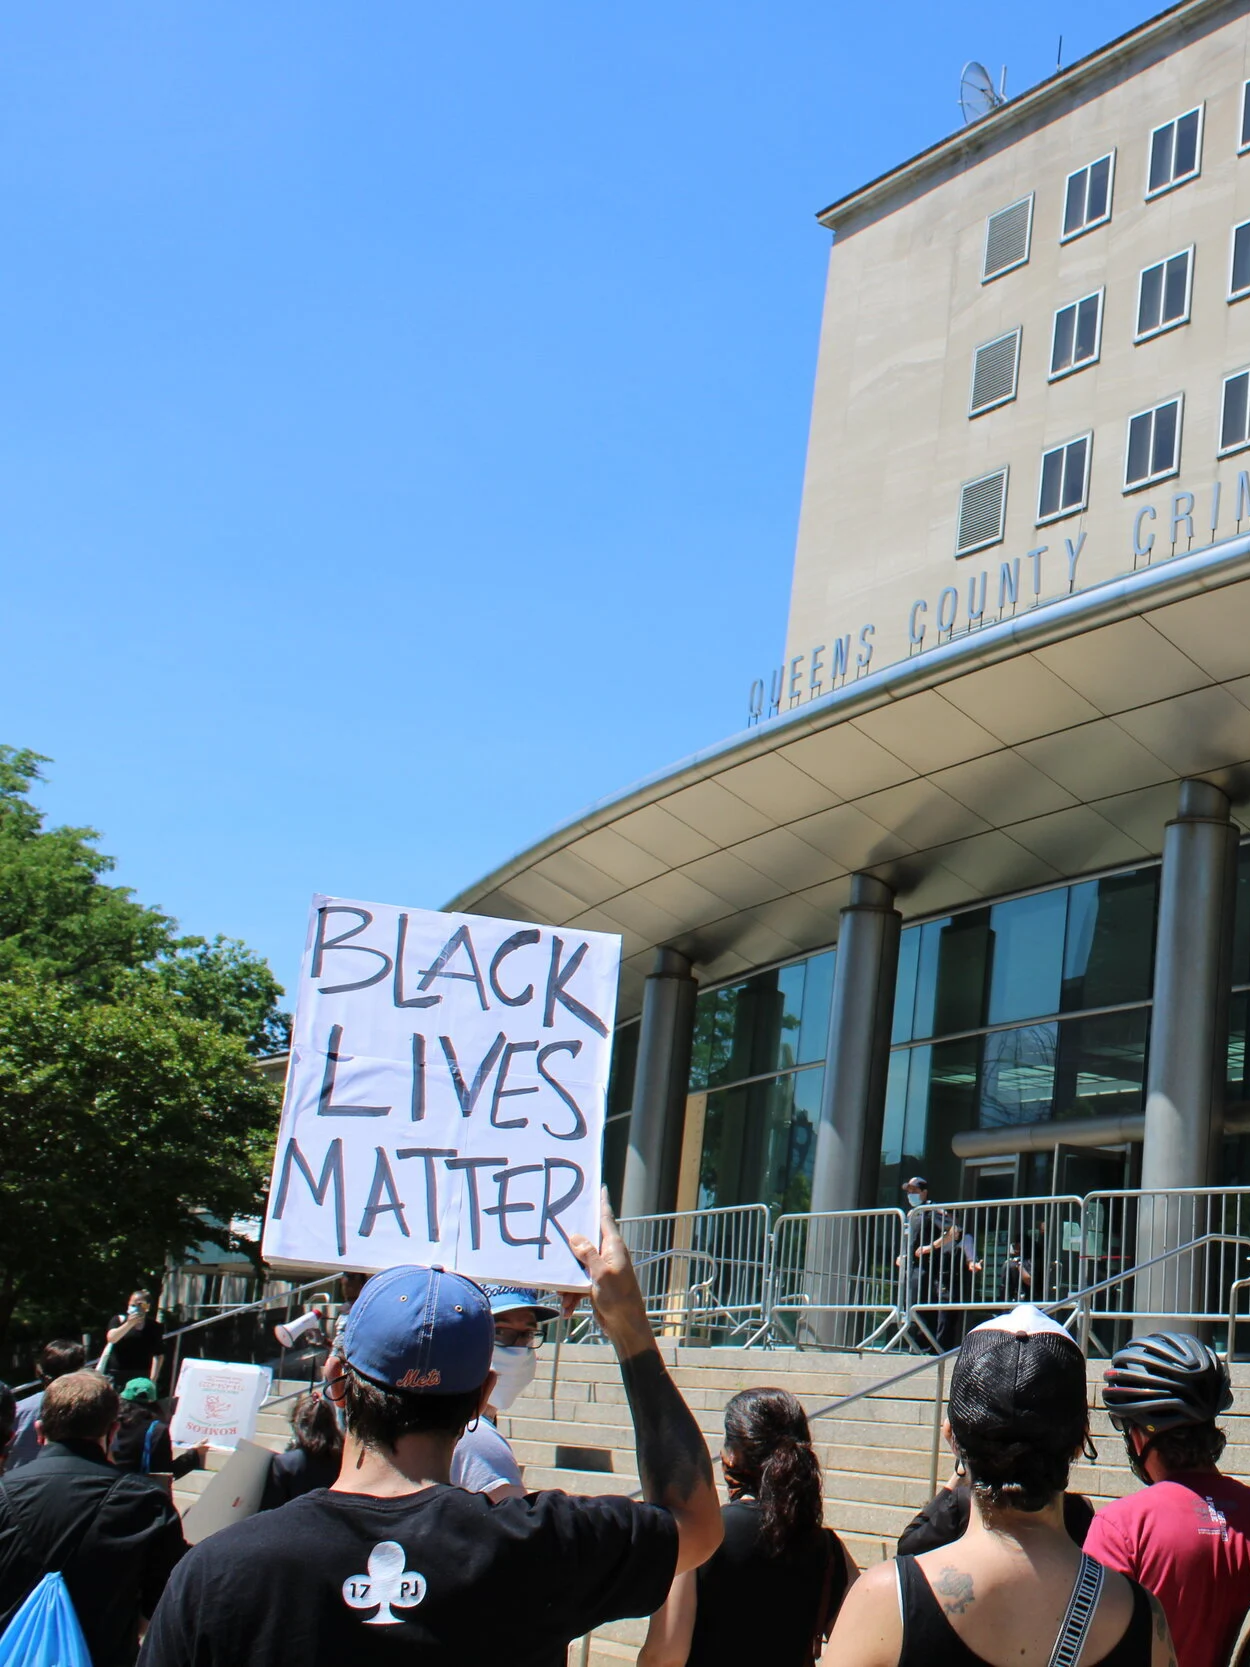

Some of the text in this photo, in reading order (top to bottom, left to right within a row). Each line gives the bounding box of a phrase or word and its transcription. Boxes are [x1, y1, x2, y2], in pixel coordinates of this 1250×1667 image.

[748, 624, 875, 718] QUEENS
[909, 532, 1087, 644] COUNTY
[310, 906, 610, 1039] BLACK
[317, 1024, 588, 1141] LIVES
[272, 1137, 585, 1260] MATTER
[396, 1368, 441, 1388] Mets
[350, 1580, 419, 1599] 17 PJ
